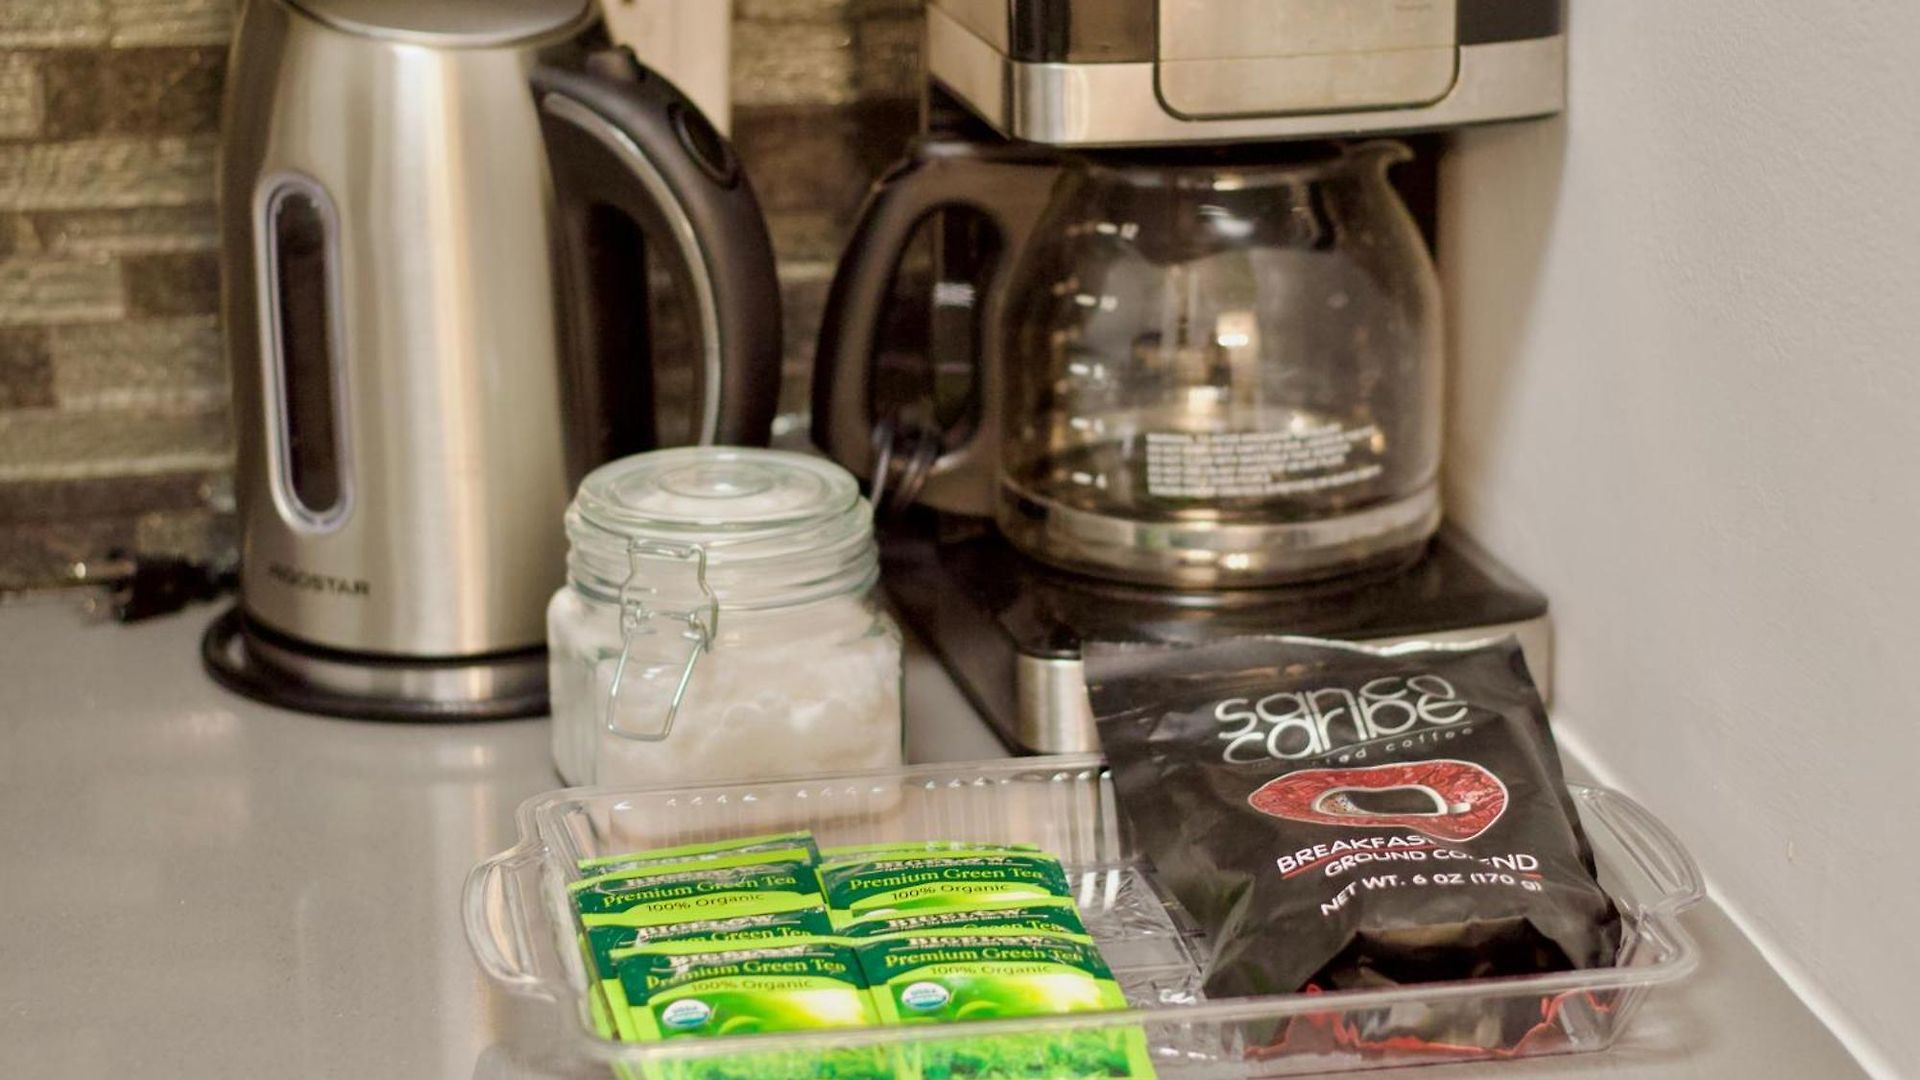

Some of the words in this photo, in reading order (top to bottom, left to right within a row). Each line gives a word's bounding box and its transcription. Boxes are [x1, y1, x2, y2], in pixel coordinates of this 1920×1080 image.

[1277, 835, 1436, 874] BREAKFAS
[1325, 850, 1428, 877] GROUND
[850, 870, 939, 891] Premium
[943, 868, 1005, 879] Green
[1008, 867, 1043, 879] Tea
[603, 884, 692, 908] Premium
[697, 879, 759, 892] Green
[761, 875, 797, 887] Tea
[892, 886, 937, 901] 100%
[940, 883, 1010, 894] Organic
[1320, 881, 1357, 917] NET
[1362, 874, 1406, 890] WT.
[1412, 874, 1428, 886] 6
[1433, 873, 1465, 885] OZ
[1470, 872, 1515, 885] (170
[647, 902, 692, 912] 100%
[695, 893, 765, 908] Organic
[743, 960, 807, 973] Green
[810, 958, 847, 972] Tea
[885, 950, 977, 967] Premium
[983, 947, 1046, 960] Green
[1049, 949, 1083, 962] Tea
[931, 964, 977, 976] 100%
[981, 965, 1051, 976] Organic
[692, 980, 739, 992] 100%
[742, 979, 814, 992] Organic
